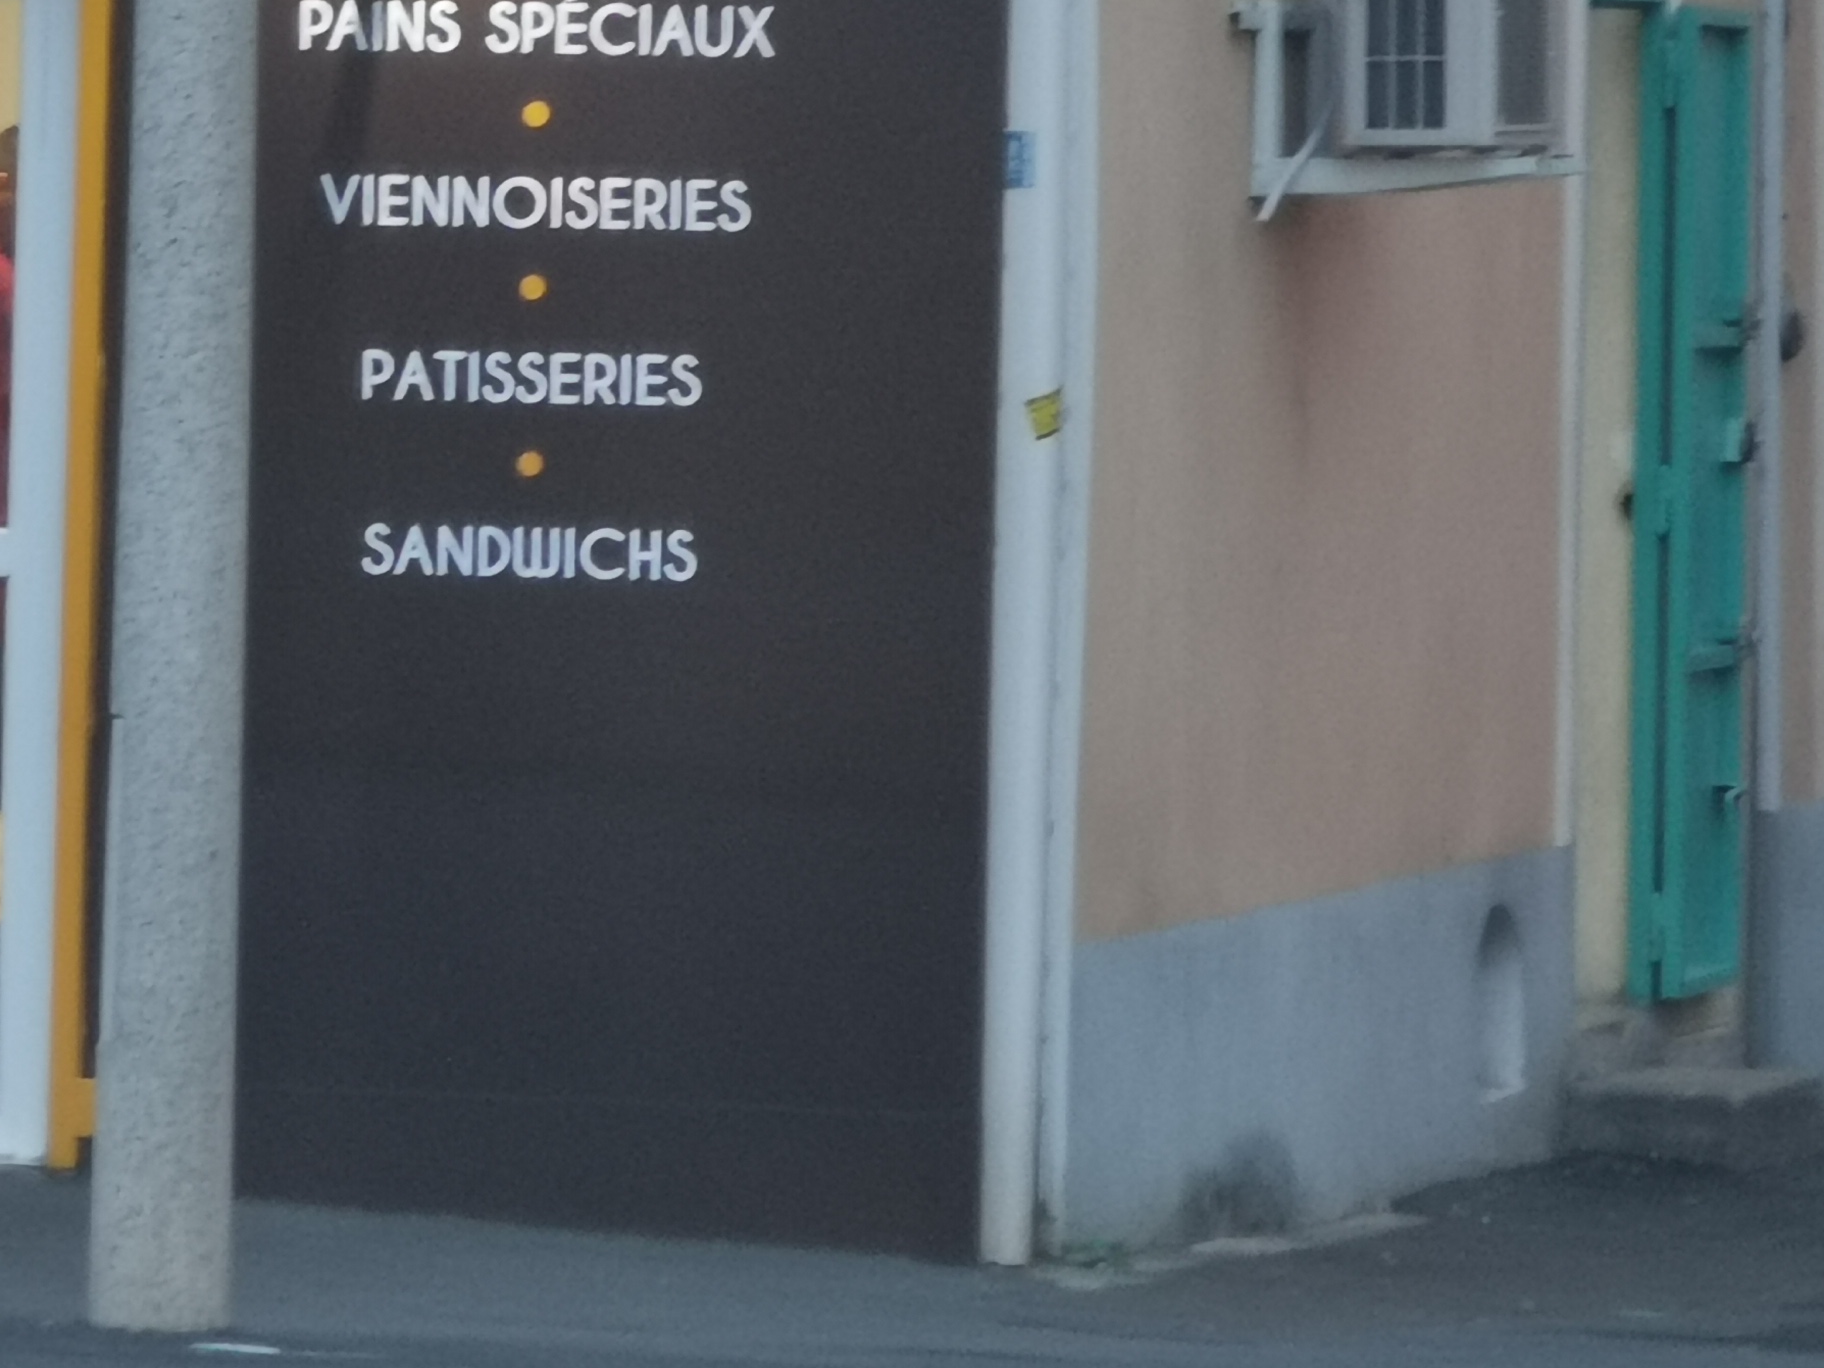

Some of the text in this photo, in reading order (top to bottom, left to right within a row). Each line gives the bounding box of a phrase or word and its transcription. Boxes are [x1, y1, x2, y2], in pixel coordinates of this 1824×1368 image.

[319, 173, 753, 232] VIENNOISERIES
[360, 348, 703, 407] PATISSERIES
[361, 522, 698, 582] SANDWICHS
